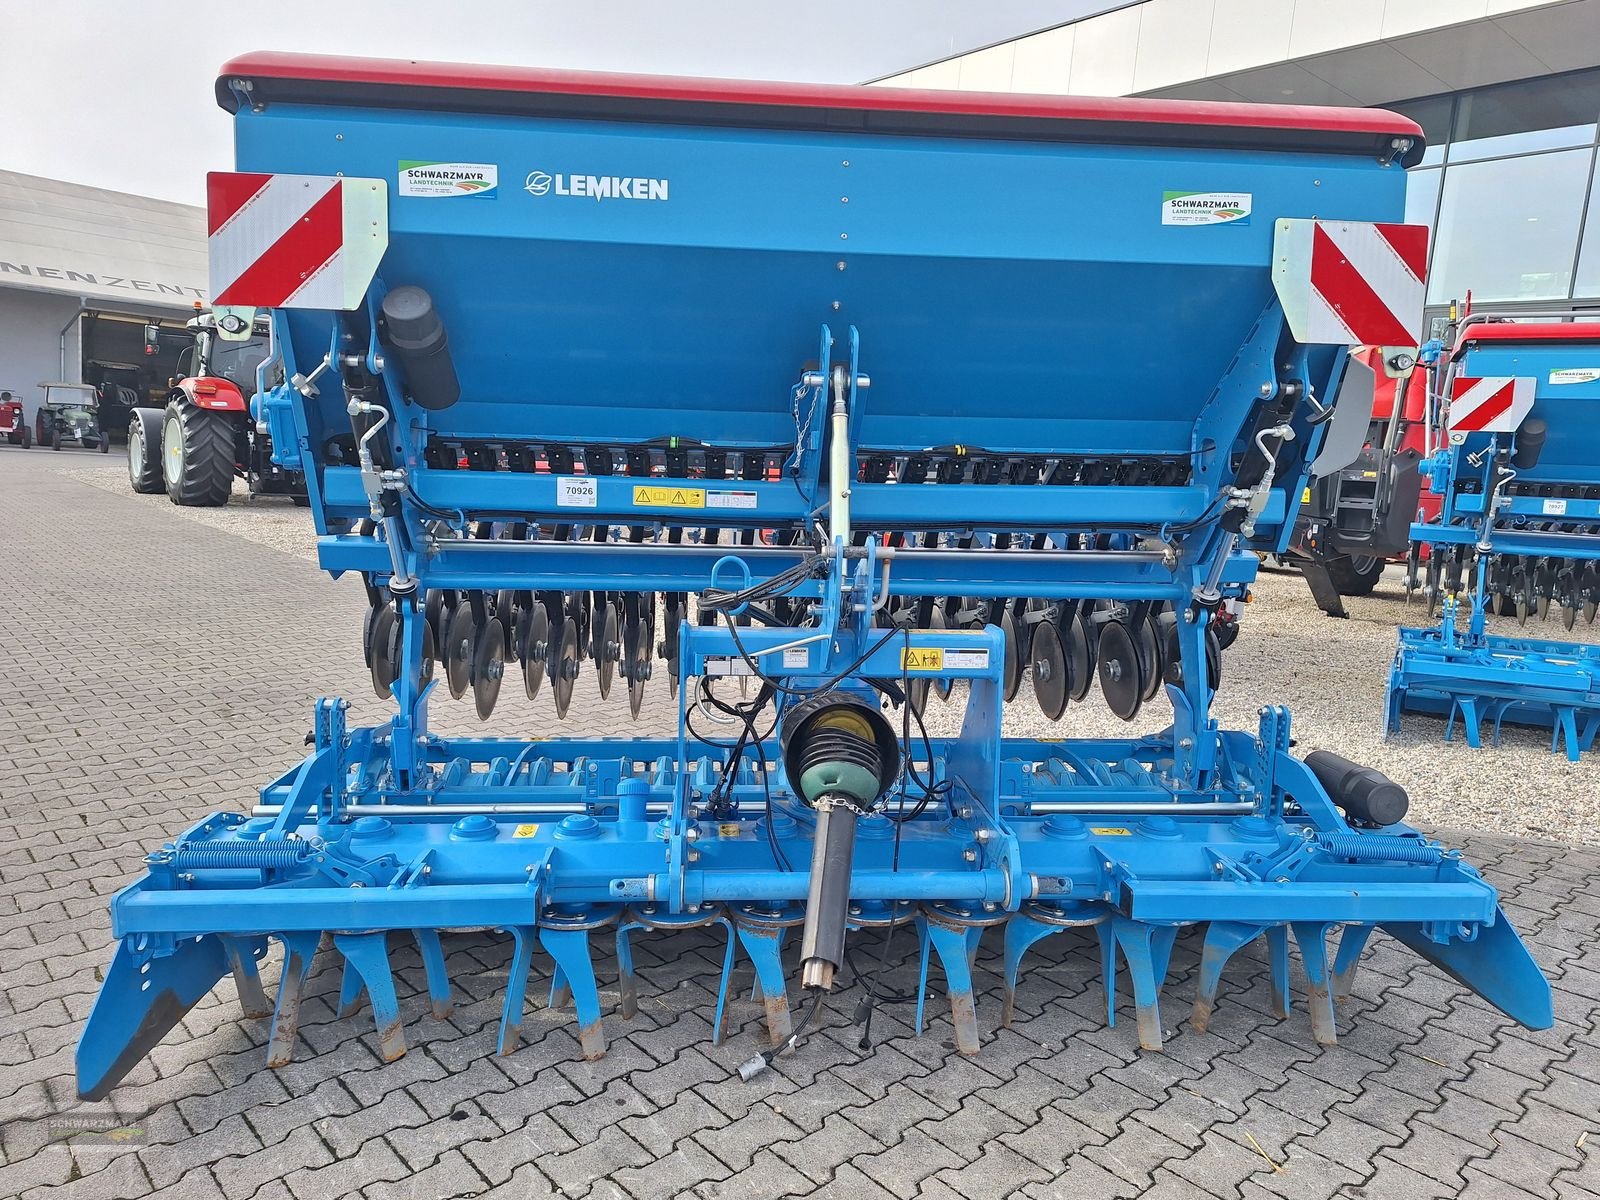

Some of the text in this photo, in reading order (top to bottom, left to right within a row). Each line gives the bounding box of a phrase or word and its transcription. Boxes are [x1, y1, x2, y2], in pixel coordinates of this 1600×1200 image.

[407, 170, 484, 180] SCHWARZMAYR
[409, 179, 454, 187] LANDTECHNIK
[555, 173, 669, 202] LEMKEN
[1171, 200, 1239, 208] SCHWARZMAYR
[566, 486, 593, 495] 70926
